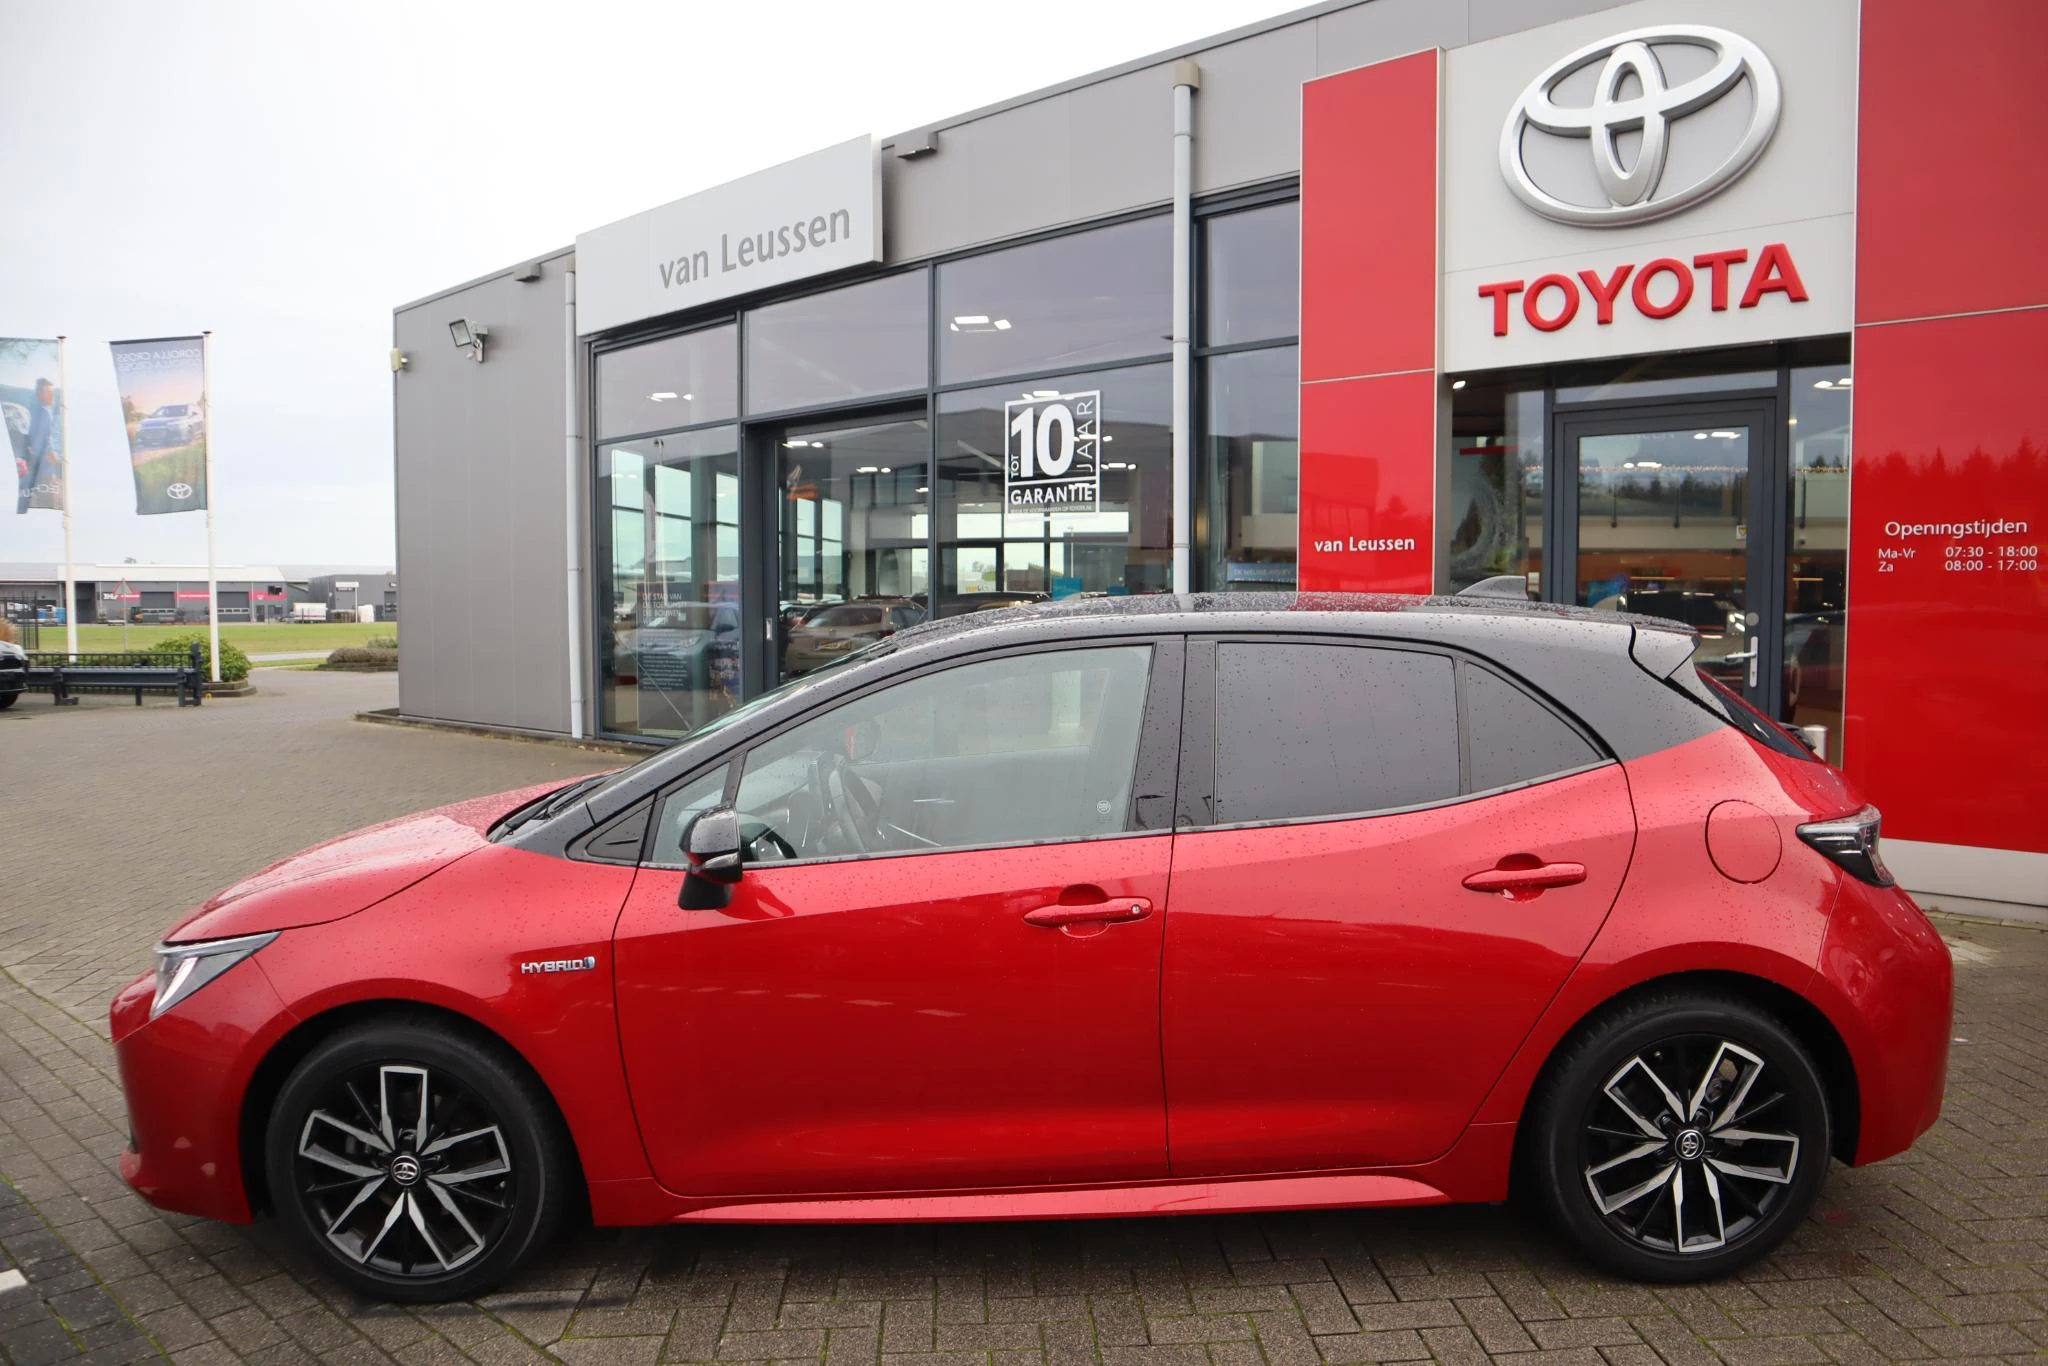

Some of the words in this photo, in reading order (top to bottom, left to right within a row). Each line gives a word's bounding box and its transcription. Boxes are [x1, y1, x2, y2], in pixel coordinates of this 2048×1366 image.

[659, 249, 709, 289] van
[721, 208, 850, 273] Leussen
[1478, 243, 1810, 337] TOYOTA
[1011, 403, 1075, 477] 10
[1076, 400, 1093, 473] JAAR
[1010, 454, 1019, 478] TOT
[1010, 486, 1093, 505] GARANTIE
[1885, 518, 2028, 539] Openingstijden
[1314, 540, 1343, 552] van
[1349, 536, 1415, 552] Leussen
[1877, 547, 1916, 559] Ma-Vr
[1945, 546, 1984, 558] 07:30
[1998, 545, 2038, 557] 18:00
[1877, 561, 1894, 572] Za
[1945, 560, 1984, 571] 08:00
[1998, 559, 2037, 571] 17:00
[521, 959, 584, 974] HYBRID
